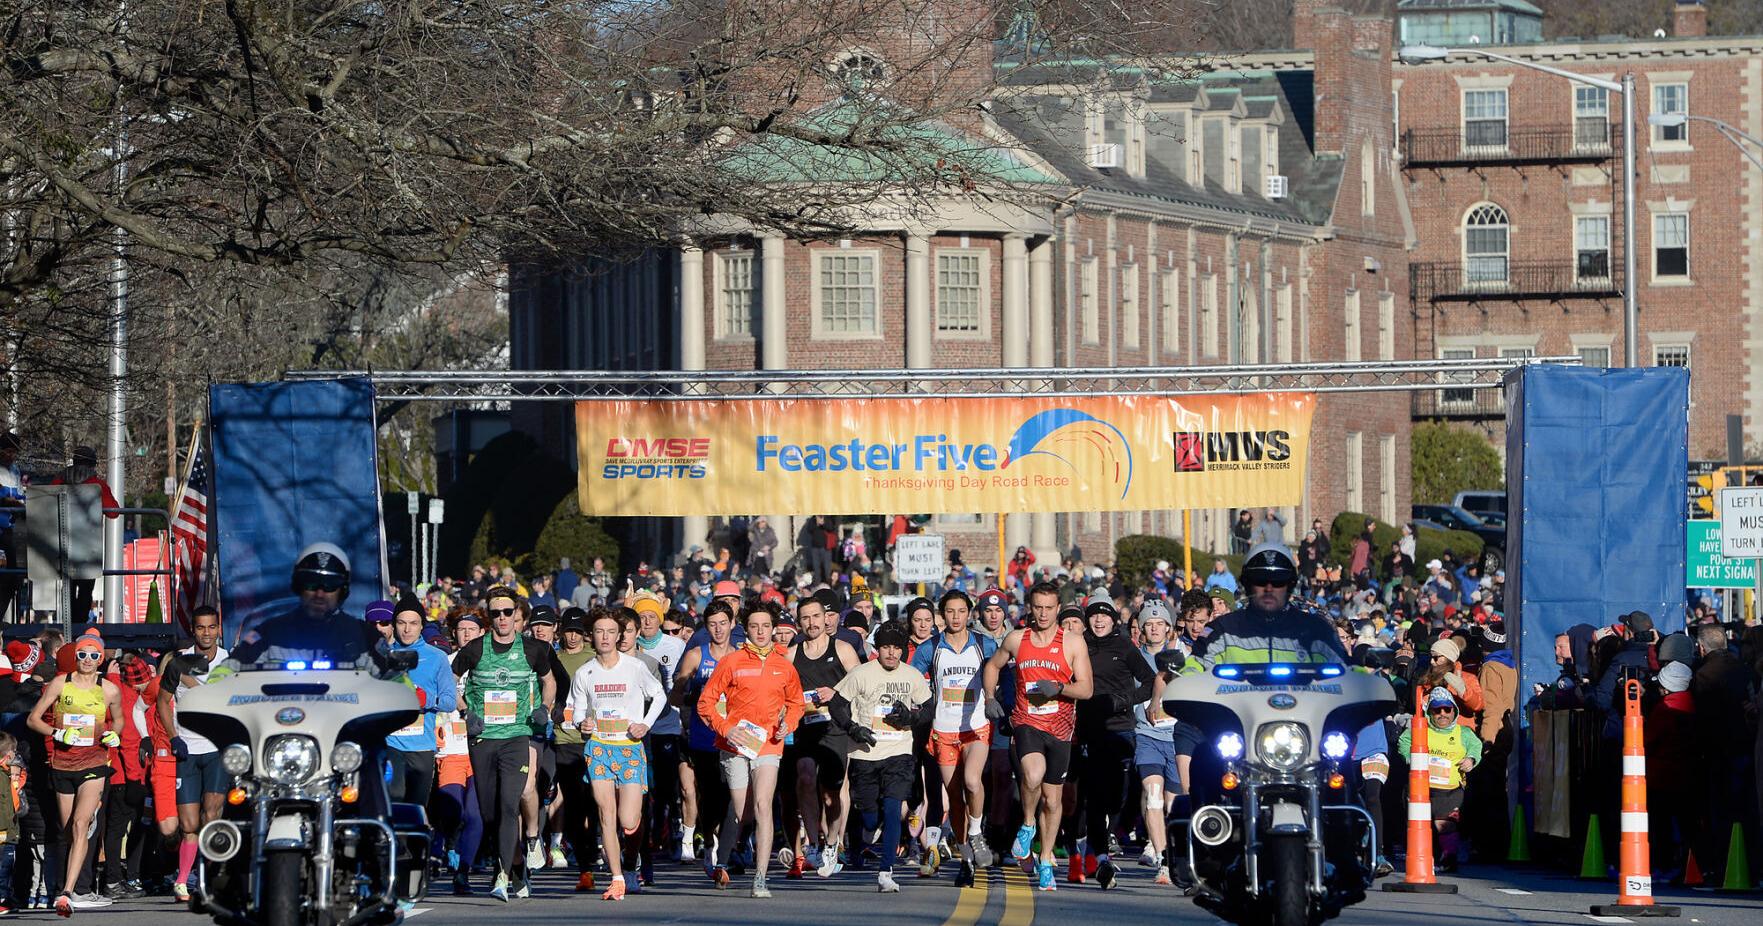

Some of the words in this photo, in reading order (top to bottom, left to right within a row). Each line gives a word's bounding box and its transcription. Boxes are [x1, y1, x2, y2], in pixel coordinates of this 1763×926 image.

[606, 438, 711, 458] DMSE
[756, 435, 908, 472] Feaster
[914, 434, 998, 471] Five
[1207, 430, 1291, 462] MVS
[602, 465, 706, 479] SPORTS
[1207, 463, 1241, 471] MERRIMACK
[1241, 463, 1262, 471] VALLEY
[1263, 462, 1291, 470] STRIDERS
[863, 476, 955, 491] Thanksgiving
[960, 475, 987, 491] Day
[992, 475, 1028, 488] Road
[1034, 475, 1070, 487] Race
[1731, 497, 1754, 508] LEFT
[1740, 515, 1763, 529] MUS
[1730, 537, 1756, 549] TURN
[1696, 565, 1721, 579] NEXT
[943, 666, 977, 677] ANDOVER
[1019, 659, 1061, 672] WHIRLAWAY
[886, 682, 911, 694] RONALD
